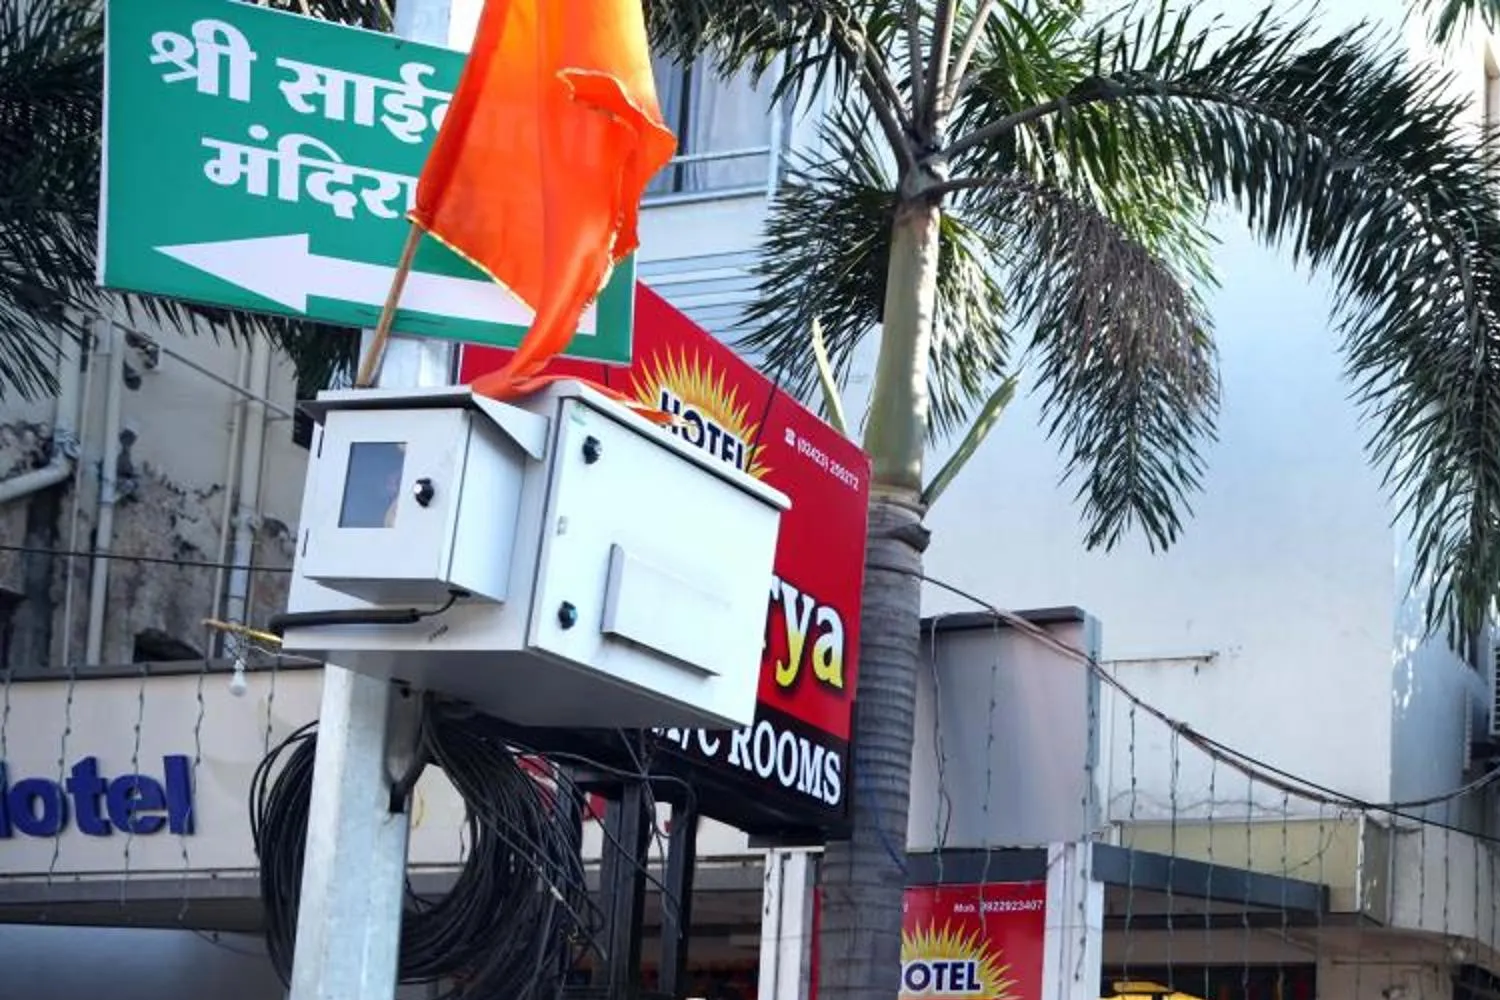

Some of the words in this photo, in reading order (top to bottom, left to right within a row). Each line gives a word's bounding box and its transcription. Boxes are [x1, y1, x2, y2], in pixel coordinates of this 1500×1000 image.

[149, 19, 257, 103] श्री
[275, 57, 453, 144] साई
[901, 961, 981, 991] OTEL
